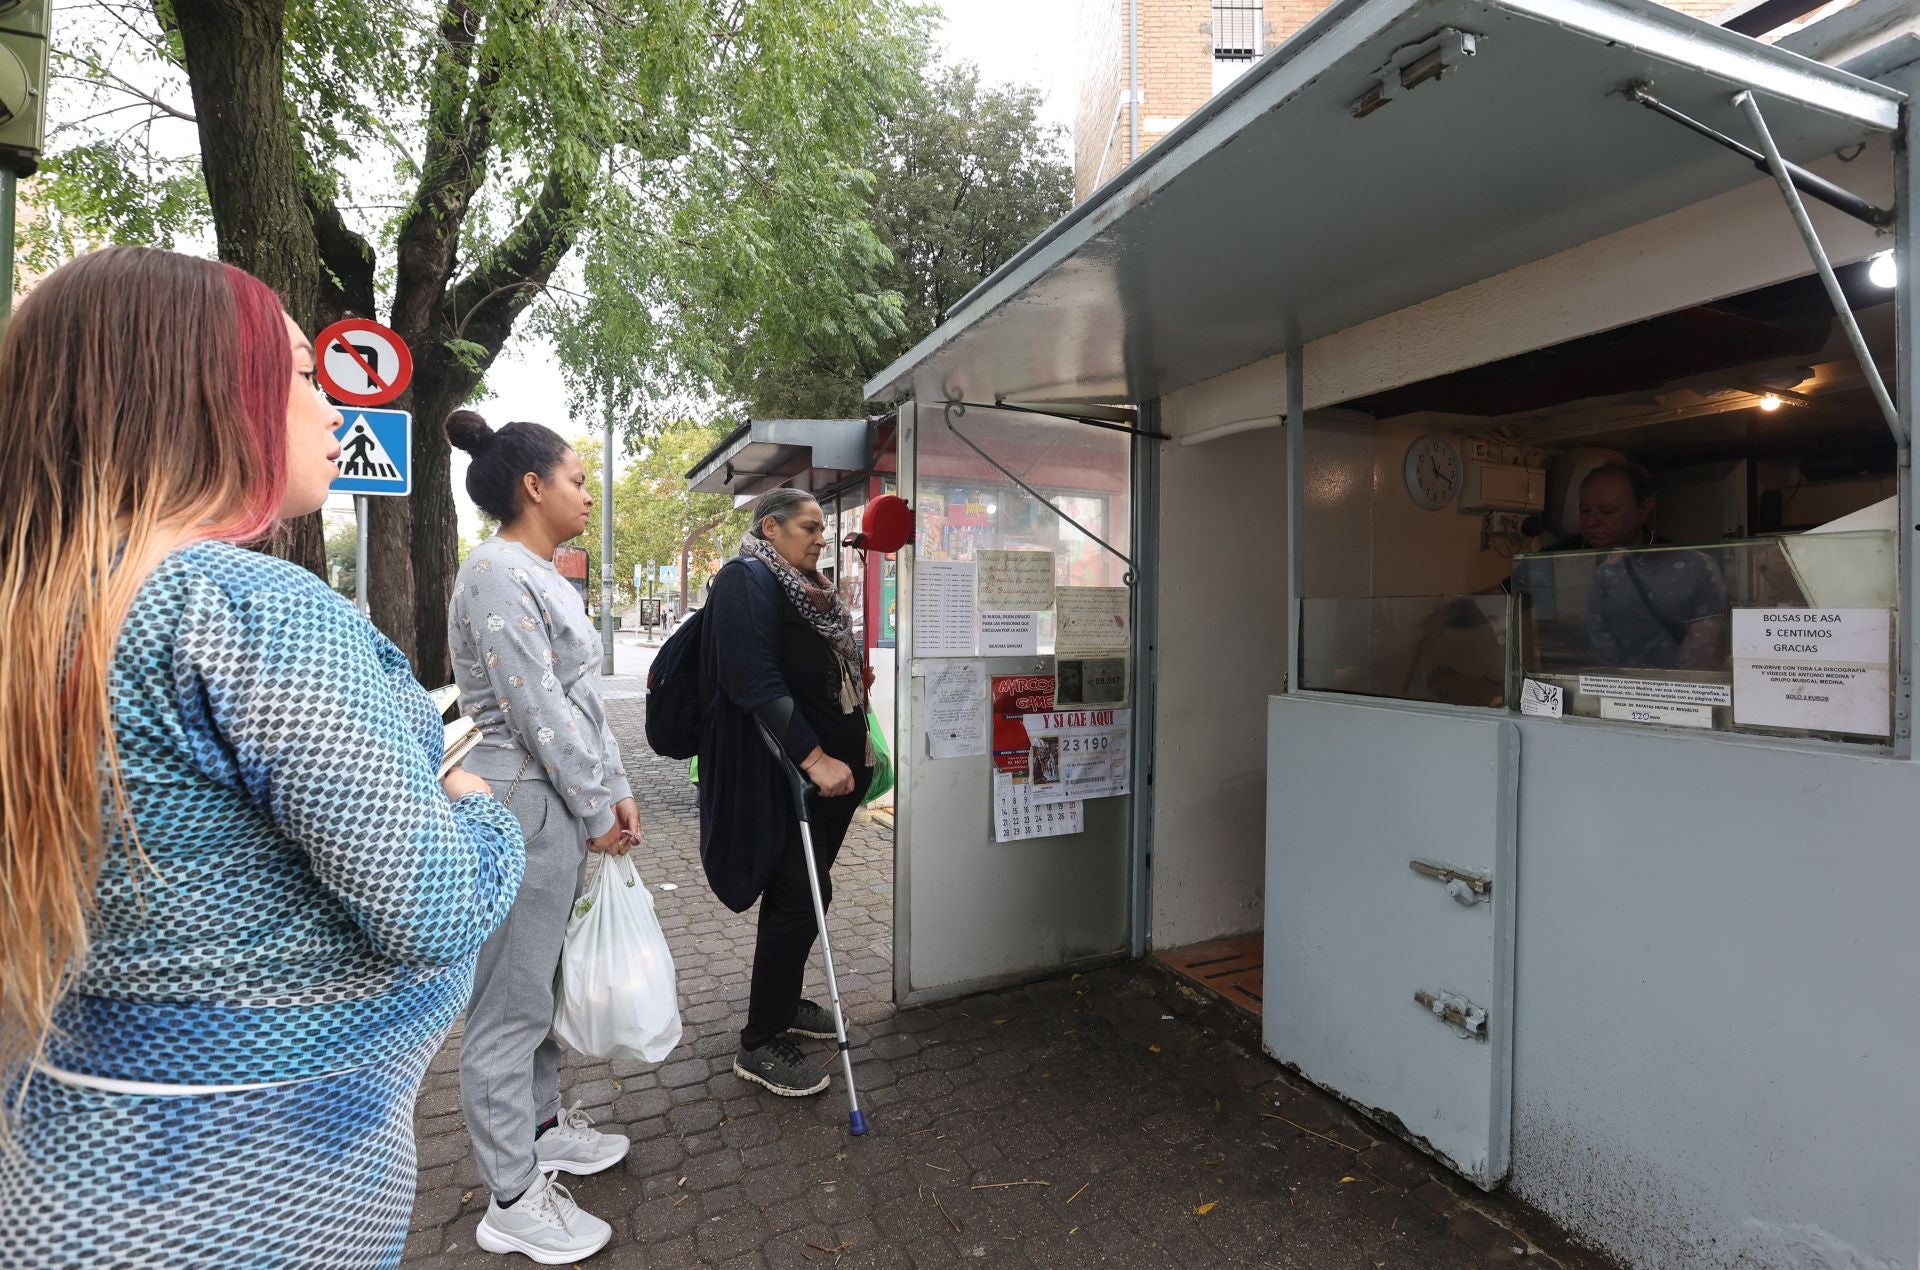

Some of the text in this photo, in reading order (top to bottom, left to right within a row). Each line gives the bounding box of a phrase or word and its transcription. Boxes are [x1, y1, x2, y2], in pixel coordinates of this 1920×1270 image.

[1764, 614, 1800, 622] BOLSAS
[1777, 629, 1832, 638] CENTIMOS
[1774, 644, 1818, 652] GRACIAS
[998, 678, 1055, 696] MARCOS
[1043, 711, 1114, 728] Y SI CAE AQUI
[1058, 802, 1063, 810] 19
